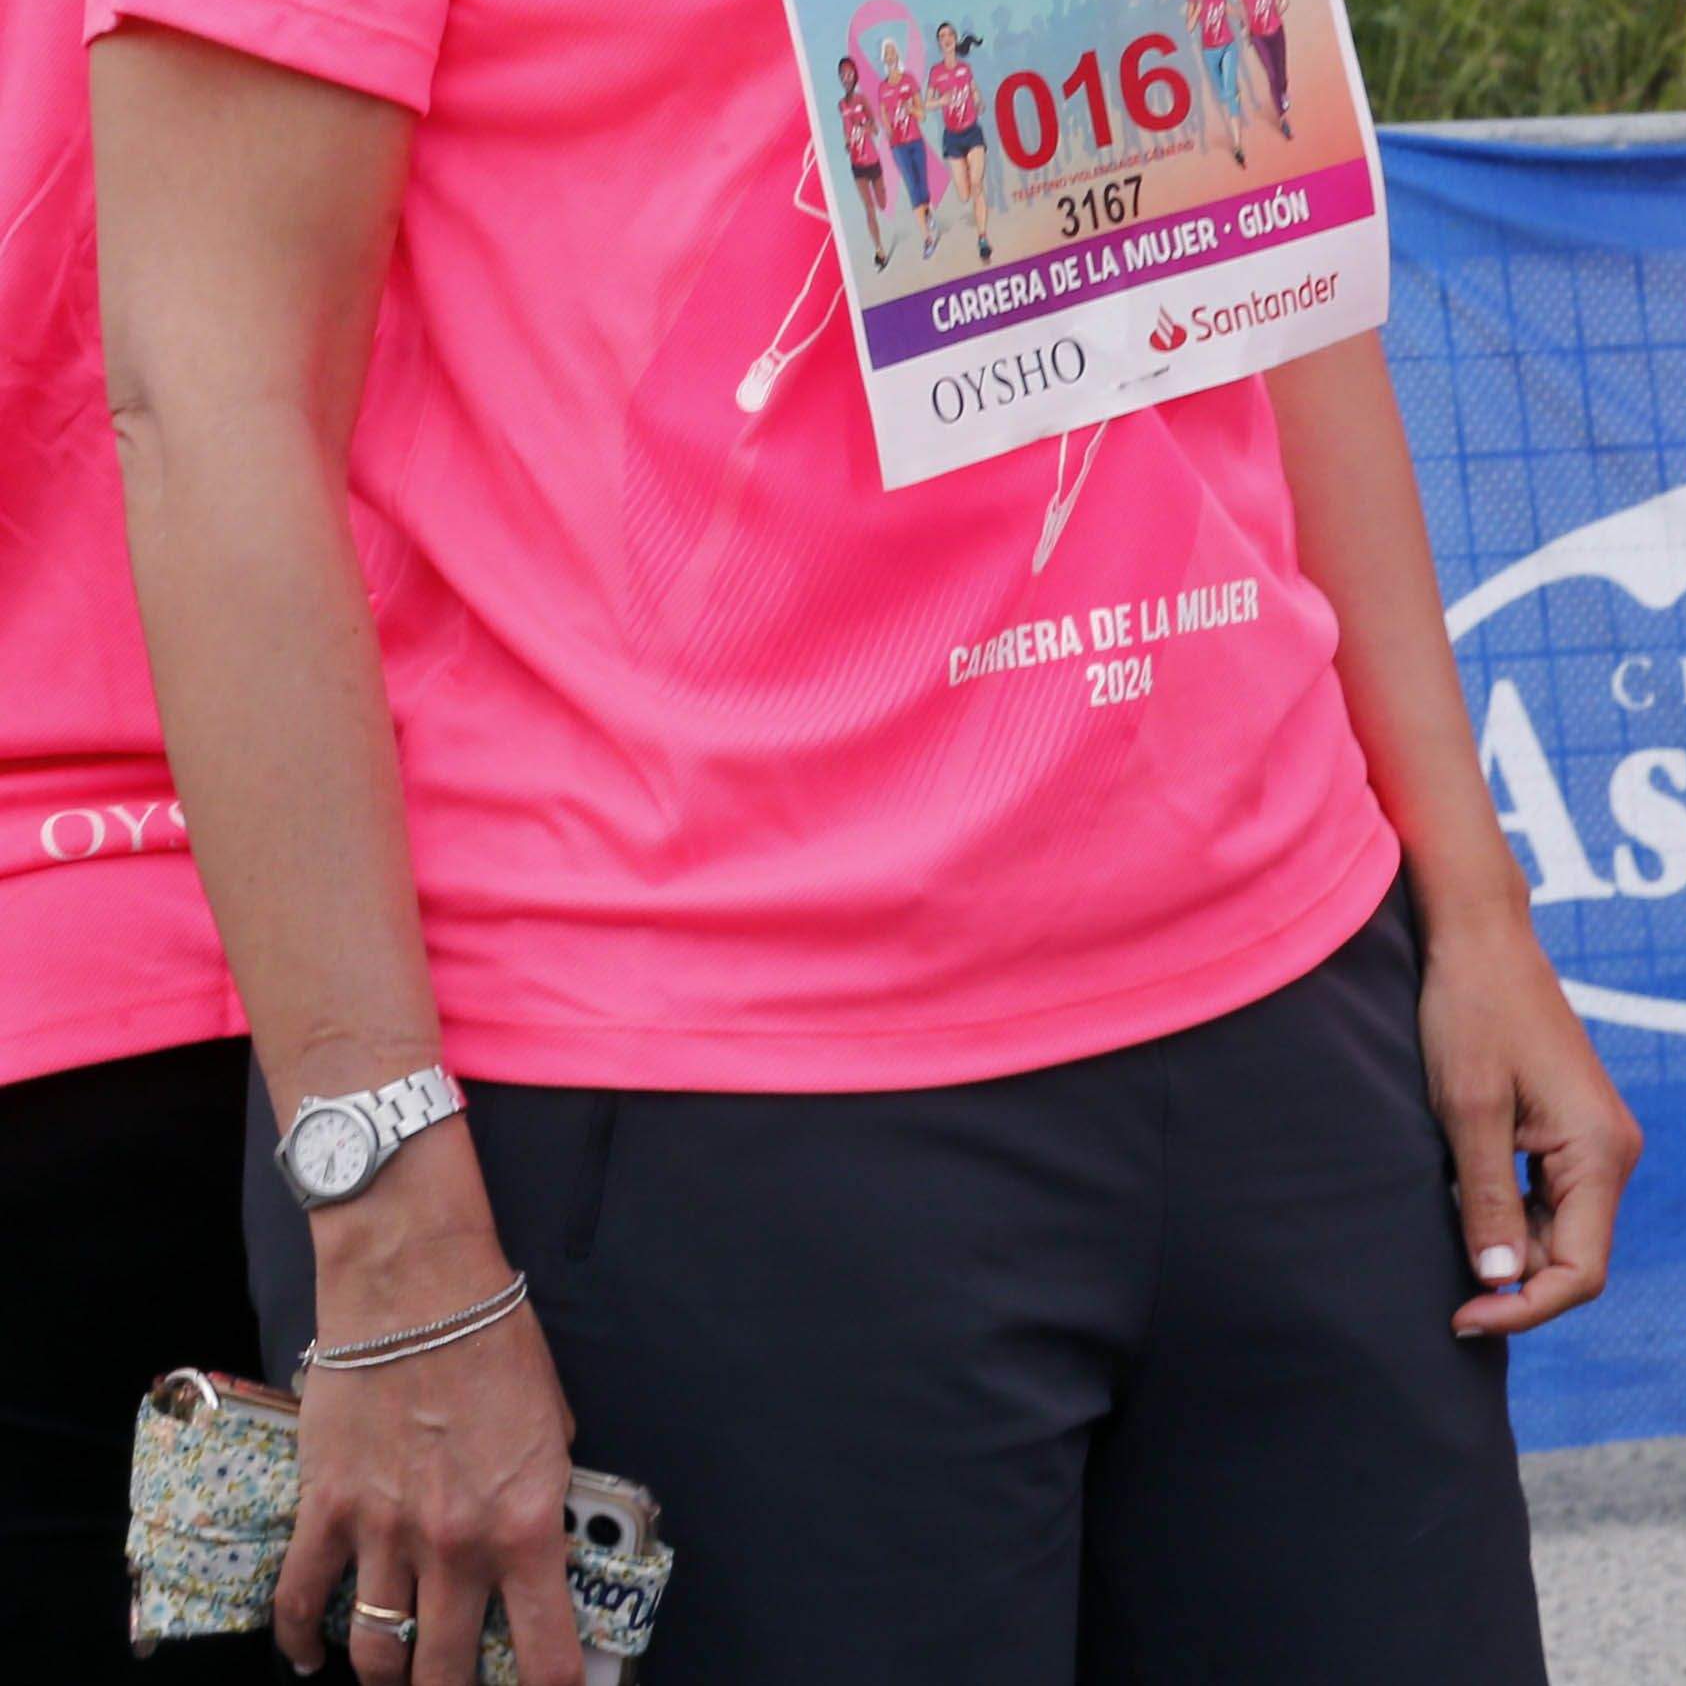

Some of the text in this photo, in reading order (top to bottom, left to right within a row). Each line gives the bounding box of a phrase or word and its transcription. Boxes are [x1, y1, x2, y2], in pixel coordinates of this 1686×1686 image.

[994, 31, 1193, 171] 016
[1056, 173, 1144, 239] 3167
[930, 185, 1311, 335] CARRERA DE LA MUJER GIJÓN
[1190, 270, 1341, 343] Santander
[930, 336, 1087, 425] OYSHO
[948, 577, 1260, 689] CARRERA DE LA MUJER
[1085, 654, 1153, 709] 2024
